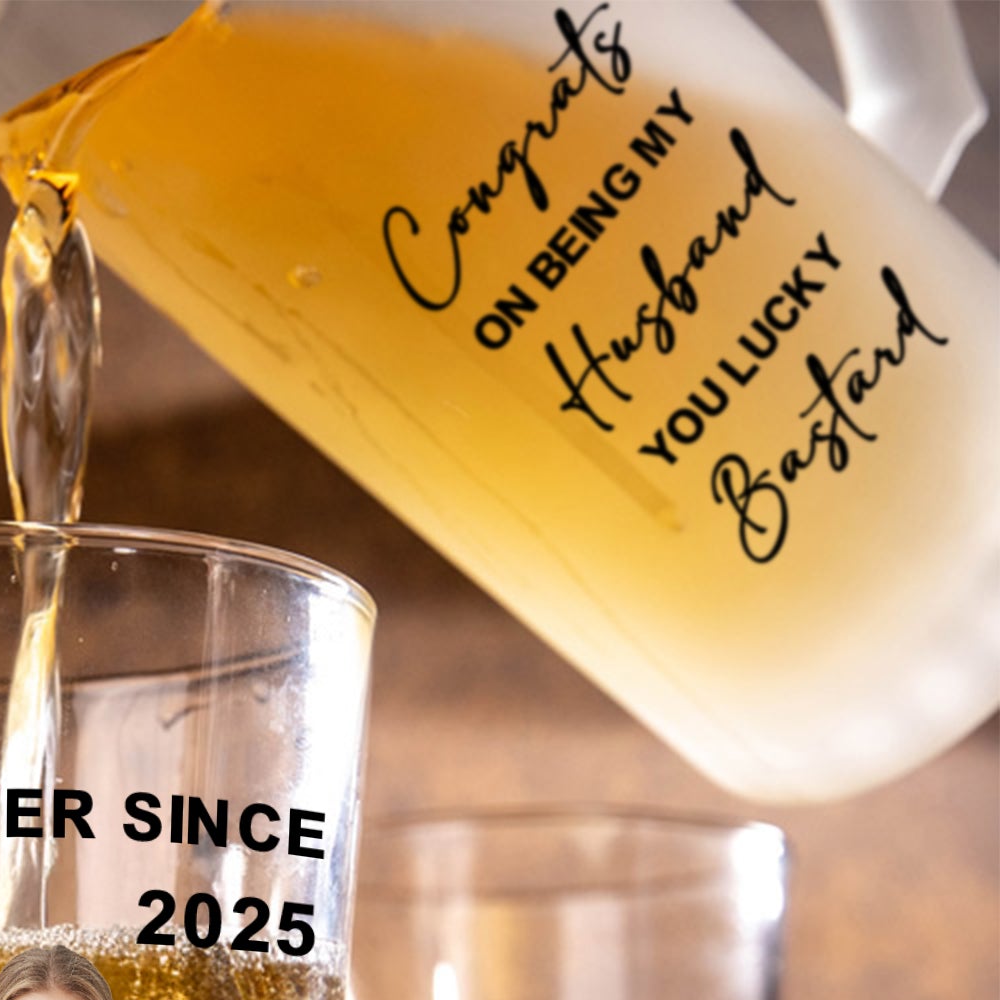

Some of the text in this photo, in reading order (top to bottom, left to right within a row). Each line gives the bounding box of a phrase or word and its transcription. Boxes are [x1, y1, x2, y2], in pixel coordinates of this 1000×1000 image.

[383, 3, 633, 311] Congrats
[473, 88, 694, 351] ON BEING MY
[545, 128, 796, 432] Husband
[638, 232, 842, 466] YOU LUCKY
[711, 266, 949, 565] Bastard
[122, 791, 327, 860] SINCE
[136, 888, 316, 957] 2025
